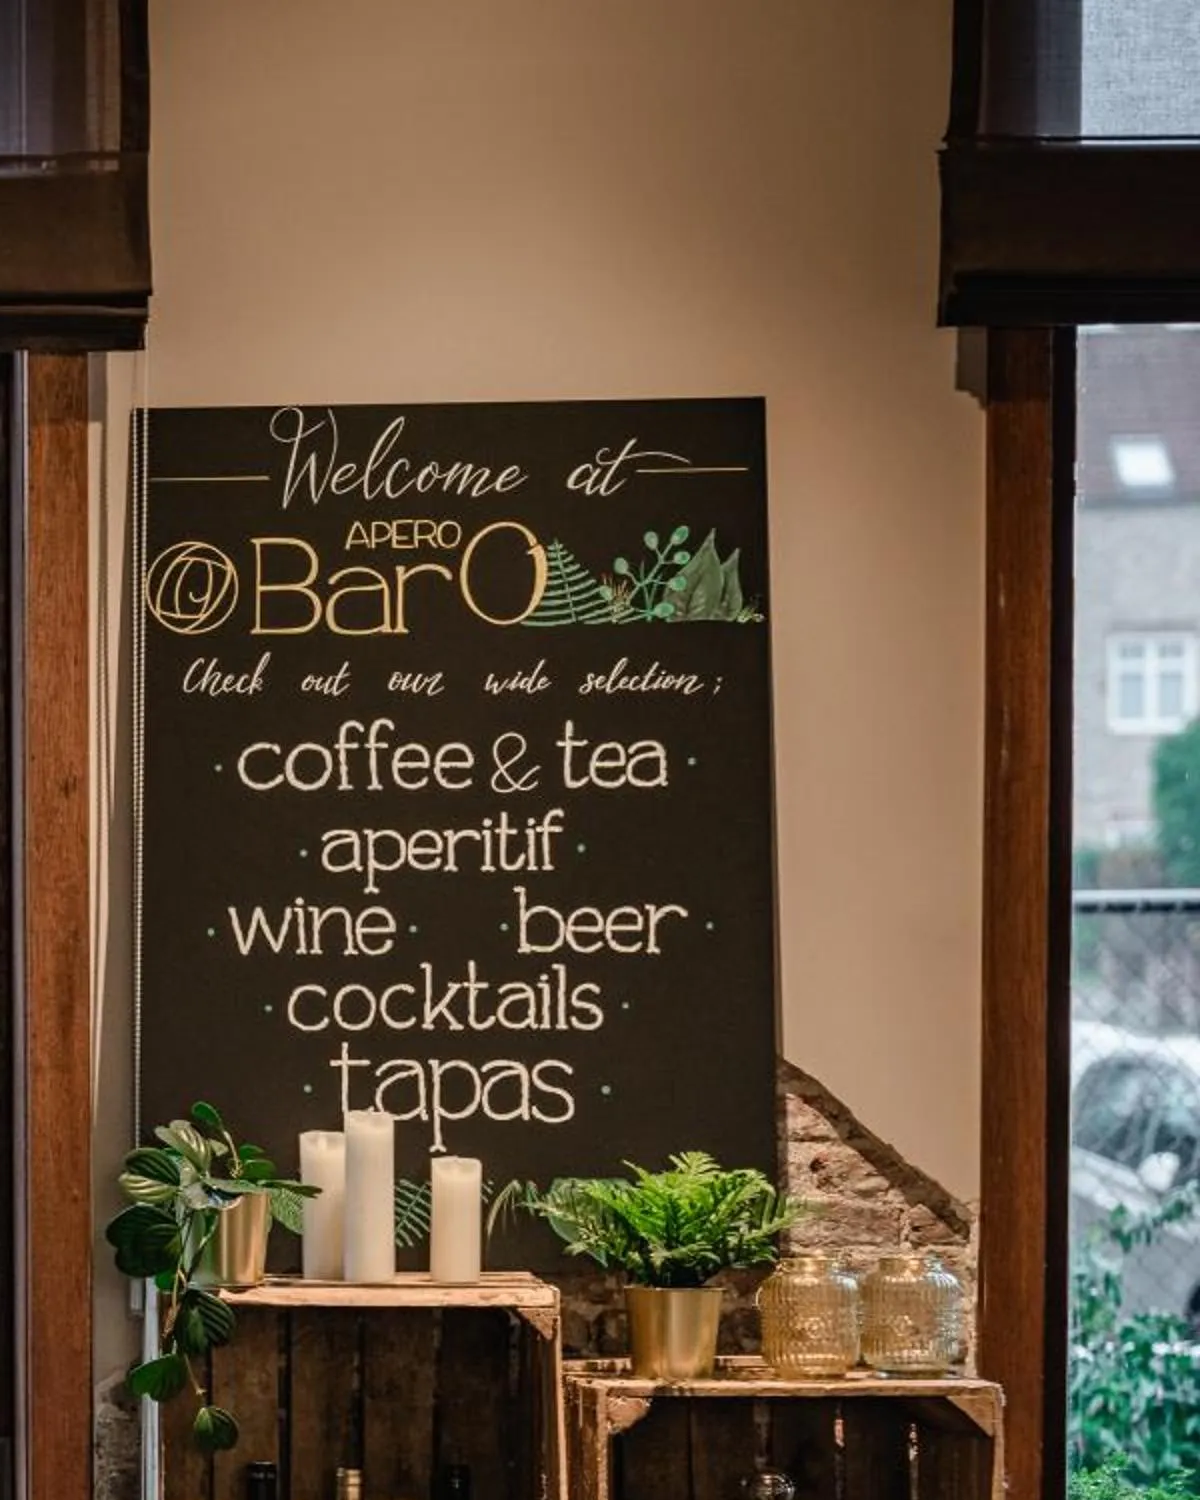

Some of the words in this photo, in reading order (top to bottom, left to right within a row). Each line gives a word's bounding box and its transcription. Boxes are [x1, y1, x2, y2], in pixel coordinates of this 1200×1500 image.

[269, 406, 530, 510] Welcome
[566, 438, 691, 497] at
[344, 518, 462, 551] APERO
[182, 651, 271, 697] Check
[300, 660, 351, 697] out
[387, 671, 445, 697] our
[483, 658, 552, 696] wide
[236, 717, 475, 792] coffee
[490, 731, 542, 793] &
[555, 719, 669, 789] tea
[320, 807, 565, 894] aperitif
[227, 896, 397, 957] wine
[513, 885, 689, 955] beer
[287, 959, 605, 1032] cocktails
[329, 1041, 576, 1153] tapas
